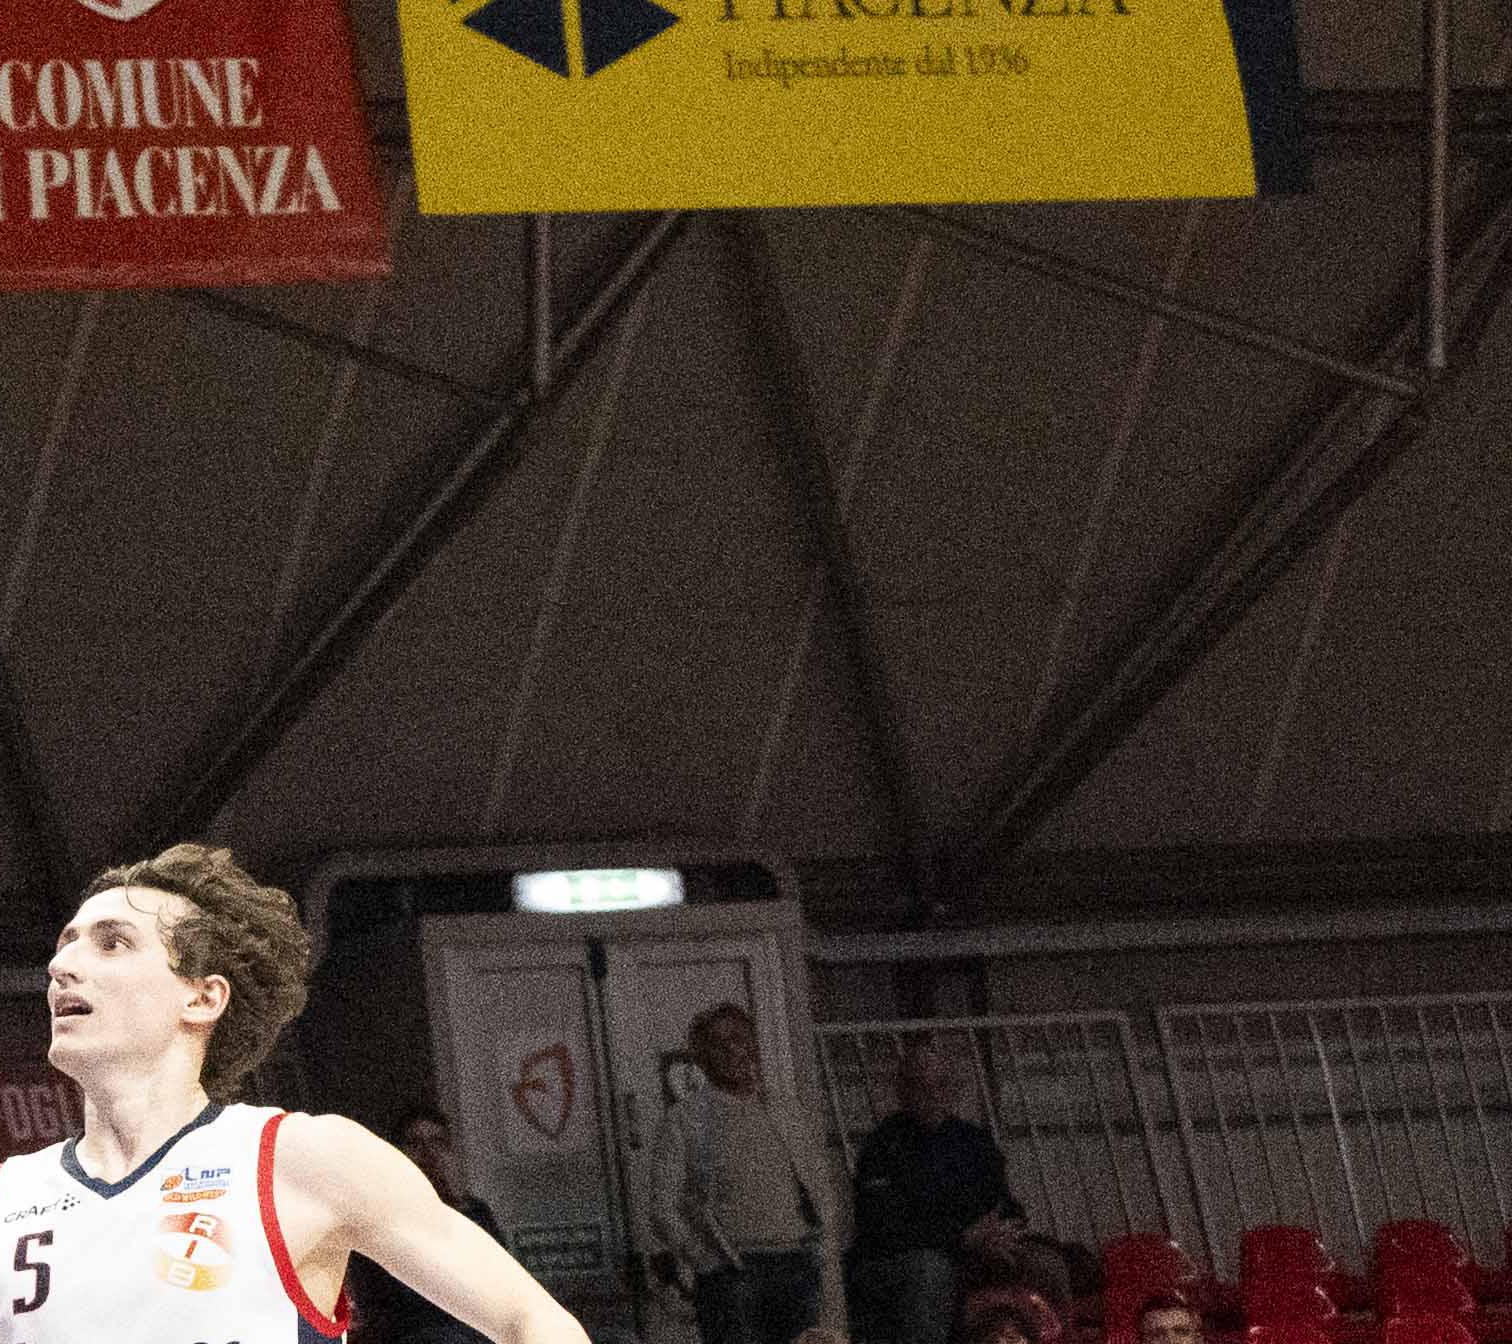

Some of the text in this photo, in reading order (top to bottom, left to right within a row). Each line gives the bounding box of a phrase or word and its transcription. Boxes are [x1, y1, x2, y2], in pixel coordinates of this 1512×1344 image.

[724, 46, 1028, 88] Indipendente dal 1936
[27, 144, 342, 220] PIACENZA
[13, 1230, 53, 1315] 5
